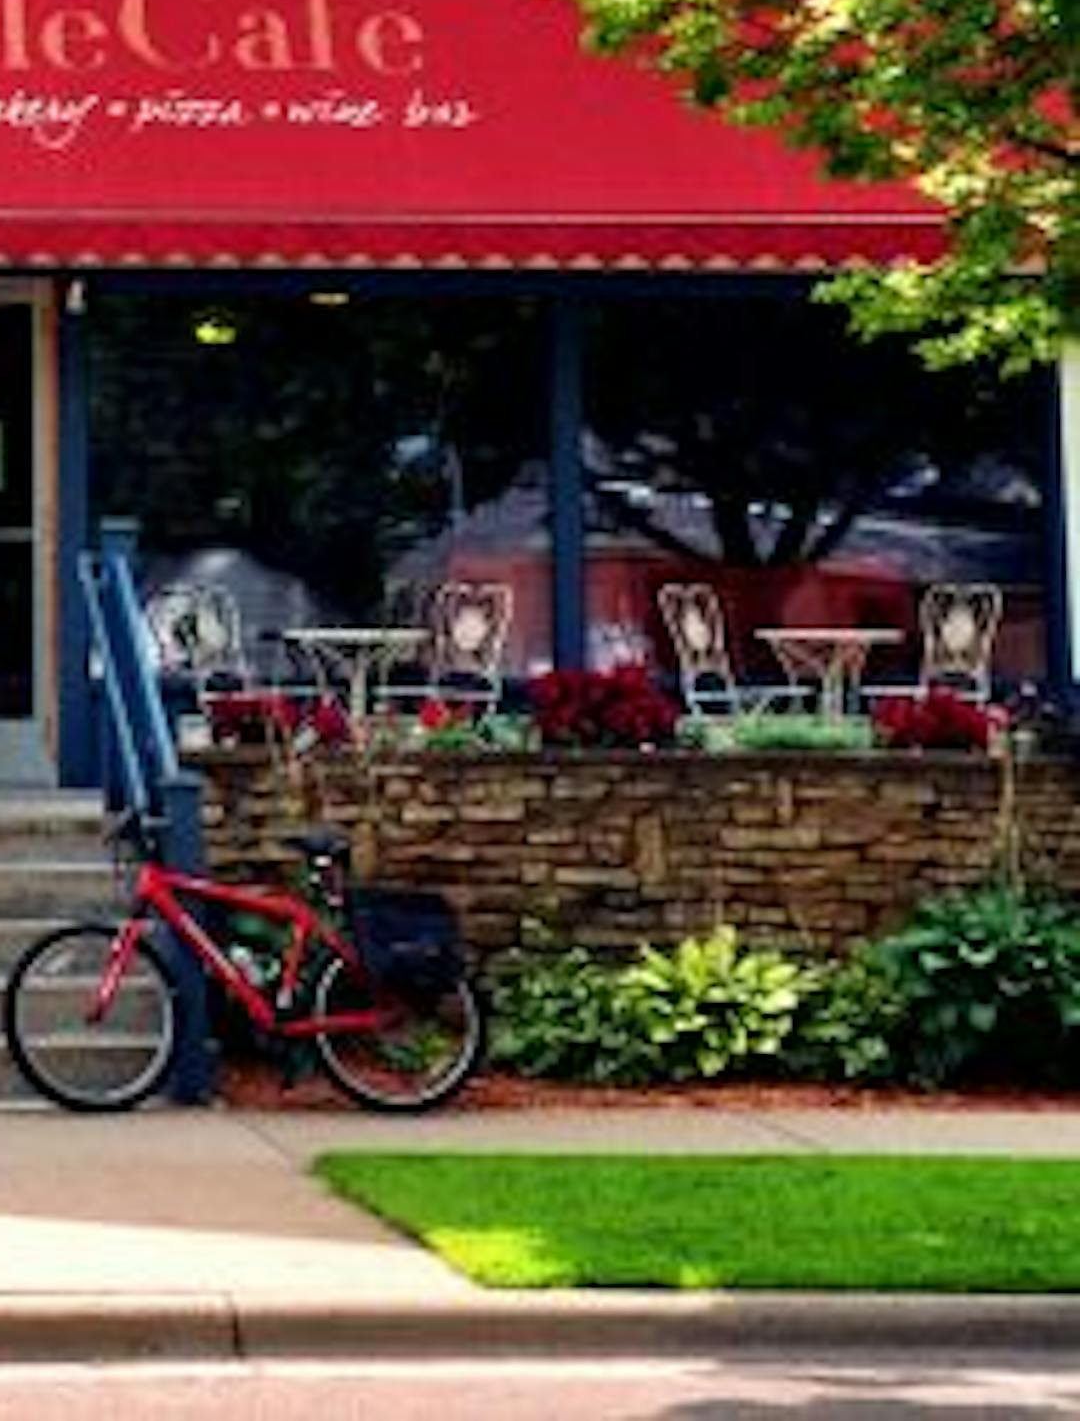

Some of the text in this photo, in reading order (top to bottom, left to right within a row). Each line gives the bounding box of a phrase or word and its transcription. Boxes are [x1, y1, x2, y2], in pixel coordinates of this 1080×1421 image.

[133, 90, 247, 132] pizza
[286, 90, 381, 128] wine
[404, 89, 477, 127] bar
